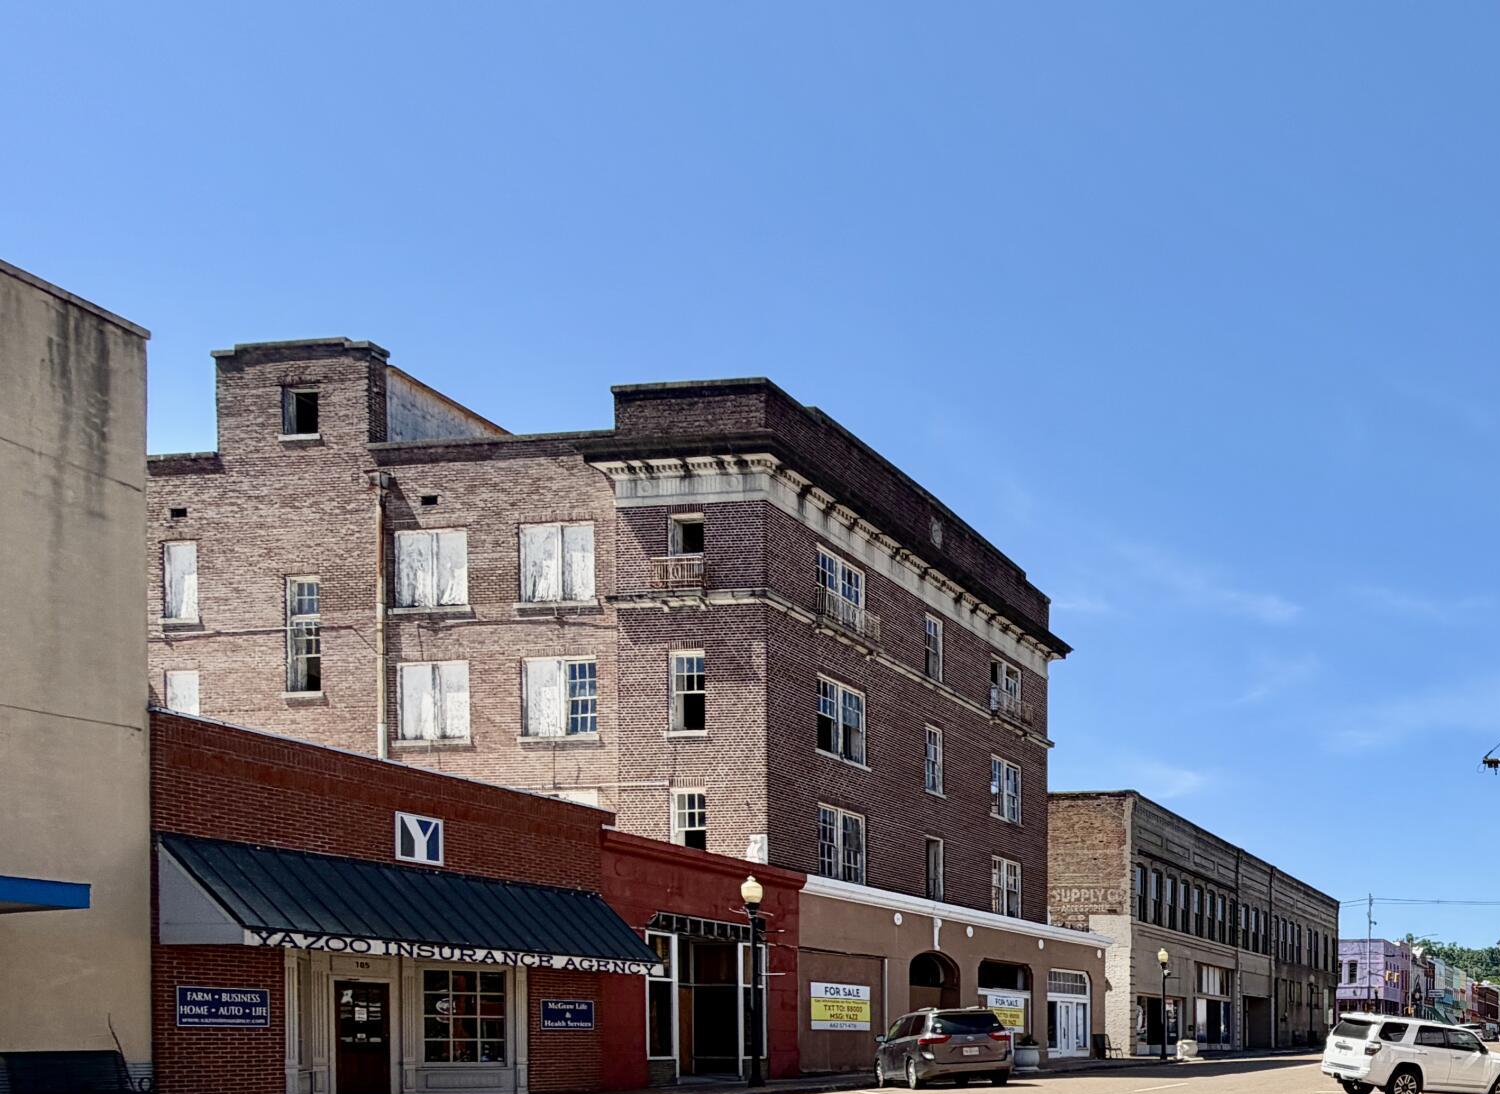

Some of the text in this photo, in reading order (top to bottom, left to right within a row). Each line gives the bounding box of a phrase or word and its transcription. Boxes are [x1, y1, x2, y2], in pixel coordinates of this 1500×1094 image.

[402, 814, 436, 861] Y
[1051, 888, 1105, 903] SUPPLY
[253, 930, 657, 976] YAZOO INSURANCE AGENCY
[355, 961, 370, 969] 105
[187, 991, 261, 1003] FARM BUSINESS
[824, 986, 861, 998] FOR SALE
[995, 998, 1018, 1007] FOR SALE
[180, 1005, 268, 1016] HOME AUTO LIFE
